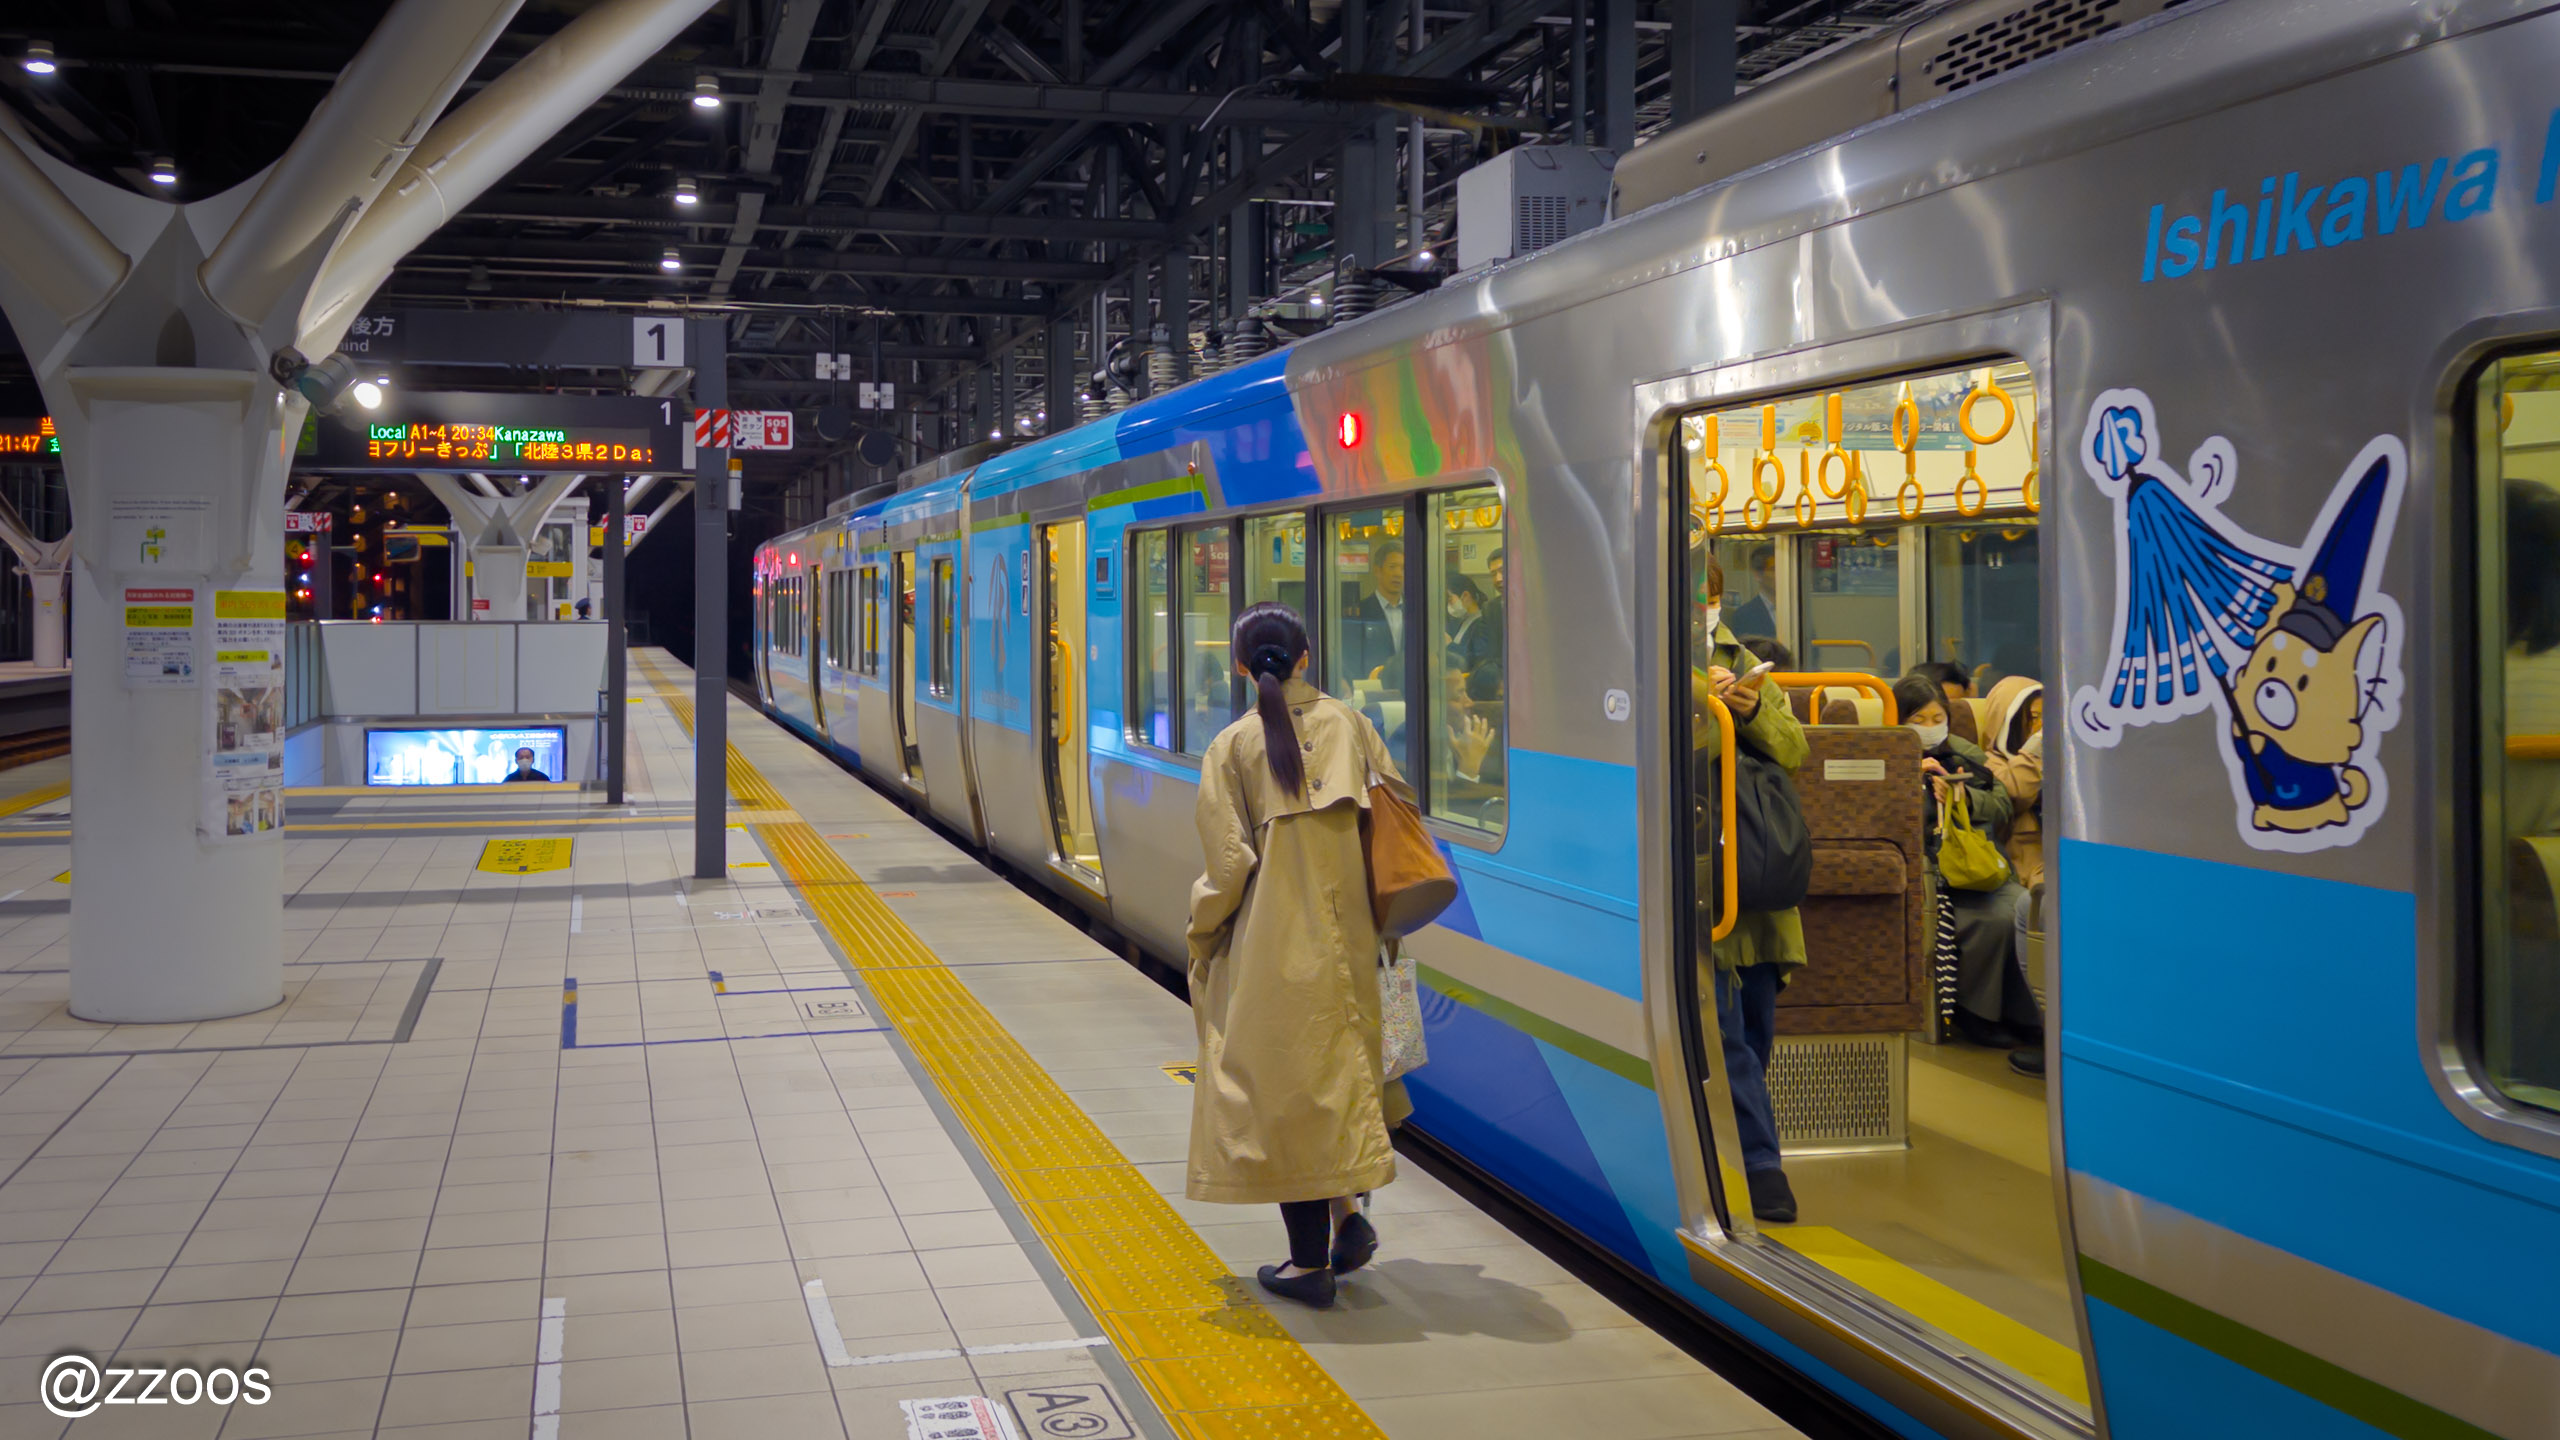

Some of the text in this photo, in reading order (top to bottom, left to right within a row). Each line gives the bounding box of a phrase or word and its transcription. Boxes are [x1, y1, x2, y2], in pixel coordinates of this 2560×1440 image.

[2140, 147, 2498, 282] Ishikawa
[647, 323, 665, 361] 1
[661, 401, 671, 426] 1
[766, 418, 787, 428] SOS
[370, 424, 406, 440] Local
[452, 425, 494, 441] 20:34
[495, 426, 565, 442] Kanazawa
